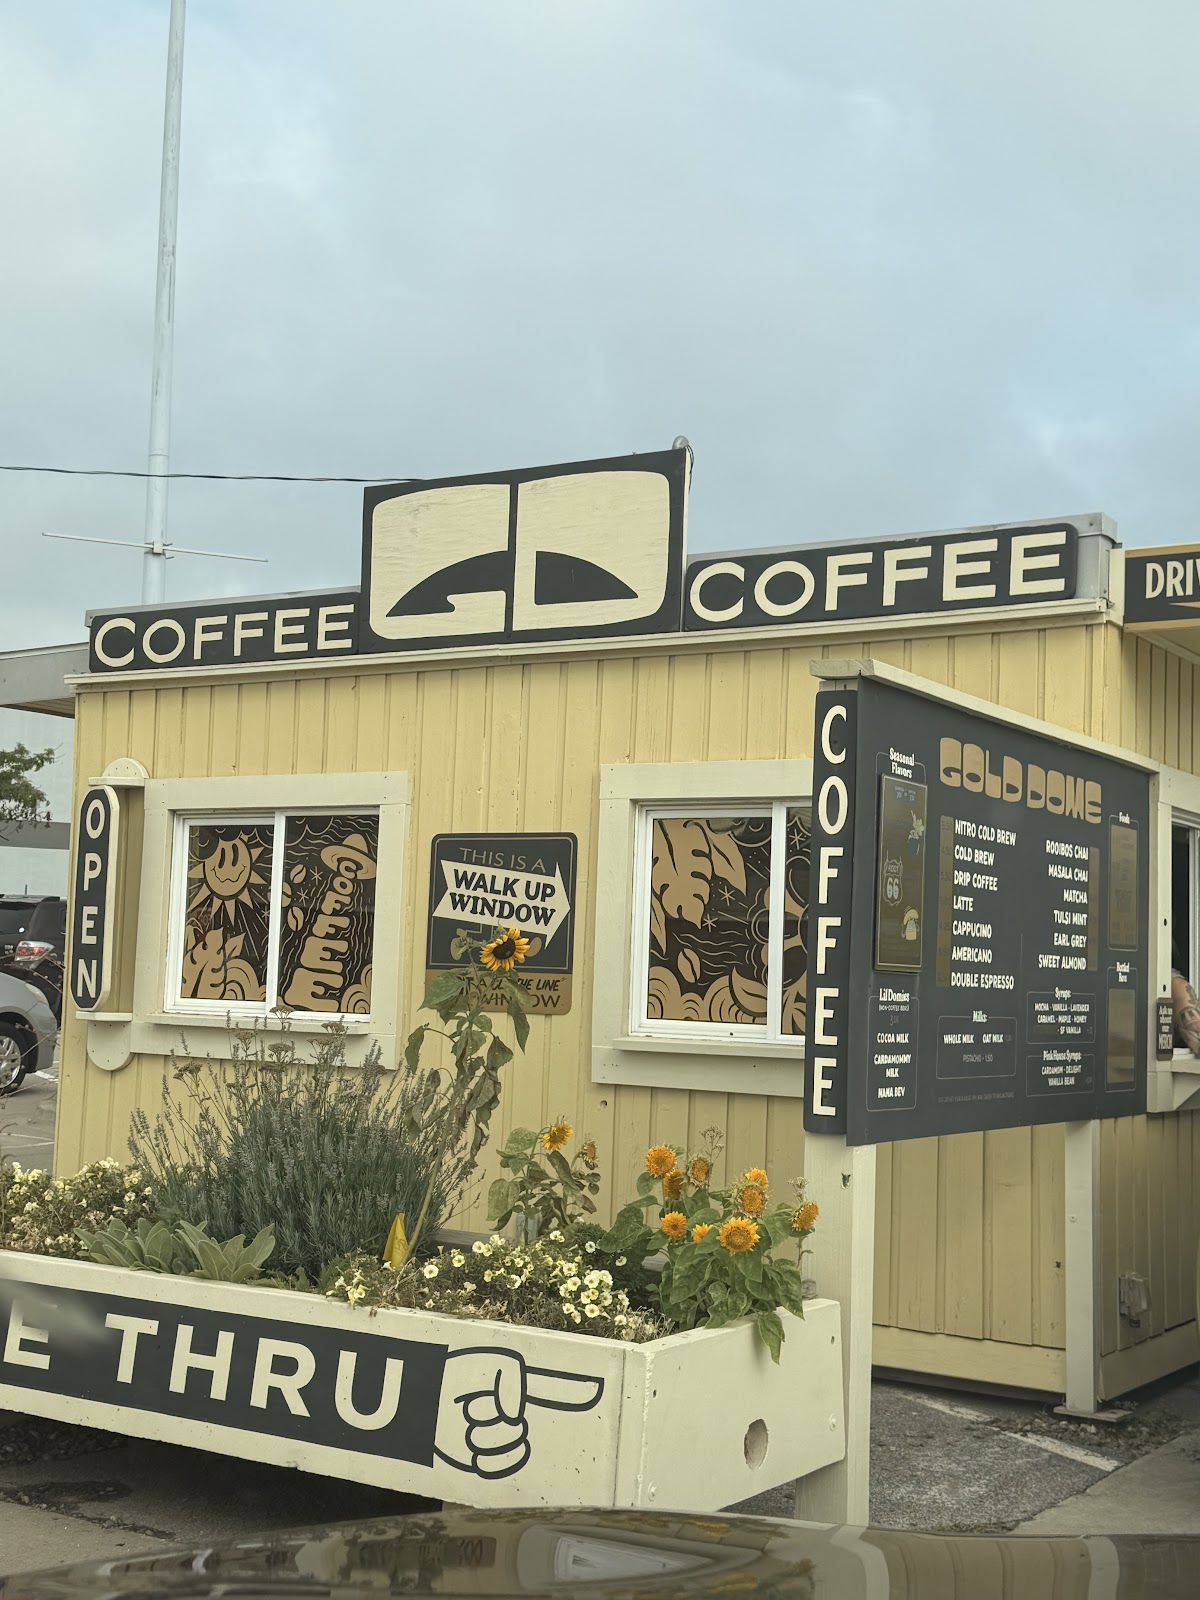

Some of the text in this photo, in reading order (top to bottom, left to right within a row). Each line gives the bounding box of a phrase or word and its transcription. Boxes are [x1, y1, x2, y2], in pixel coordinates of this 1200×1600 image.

[689, 531, 1067, 623] COFFEE
[1145, 558, 1200, 599] DRI
[94, 603, 355, 668] COFFEE
[889, 747, 915, 766] Seasonal
[891, 762, 912, 778] Flavors
[940, 737, 1102, 824] GOLD DOME
[954, 819, 977, 838] NITRO
[978, 825, 995, 842] COLD
[996, 828, 1017, 846] BREW
[954, 844, 973, 862] COLD
[974, 848, 995, 866] BREW
[1045, 839, 1089, 860] ROOIBOS CHAI
[459, 847, 547, 873] THIS IS A
[953, 869, 971, 887] DRIP
[972, 873, 998, 891] COFFEE
[1048, 863, 1073, 880] MASALA
[1073, 867, 1089, 882] CHAI
[453, 868, 556, 902] WALK UP
[886, 876, 899, 900] 66
[76, 799, 105, 999] OPEN
[953, 895, 974, 912] LATTE
[1063, 888, 1088, 904] MATCHA
[450, 892, 556, 927] WINDOW
[812, 705, 849, 1116] COFFEE
[1053, 909, 1088, 926] TULSI MINT
[284, 860, 357, 1012] COFFEE
[952, 920, 993, 939] CAPPUCINO
[1053, 932, 1087, 948] EARL GREY
[951, 946, 993, 964] AMERICANO
[1038, 953, 1087, 970] SWEET ALMOND
[951, 971, 979, 988] DOUBLE
[980, 973, 1015, 990] ESPRESSO
[480, 993, 560, 1008] WINOW
[1034, 1002, 1090, 1012] MOCHA VANILLA LAVENDER
[1037, 1014, 1088, 1024] CARAMEL MAPLE HONEY
[876, 1032, 909, 1043] COCOA MILK
[943, 1033, 974, 1044] WHOLE MILK
[982, 1033, 992, 1044] OAT
[992, 1033, 1004, 1043] MILK
[1066, 1026, 1081, 1034] VANILLA
[1158, 1033, 1173, 1050] MERCH
[873, 1053, 912, 1065] CARDAMOMMY
[885, 1067, 900, 1078] MILK
[1041, 1064, 1082, 1075] CARDAMOM DELIGHT
[1048, 1077, 1063, 1086] VANILLA
[1064, 1076, 1075, 1086] BEAN
[104, 1312, 404, 1431] THRU
